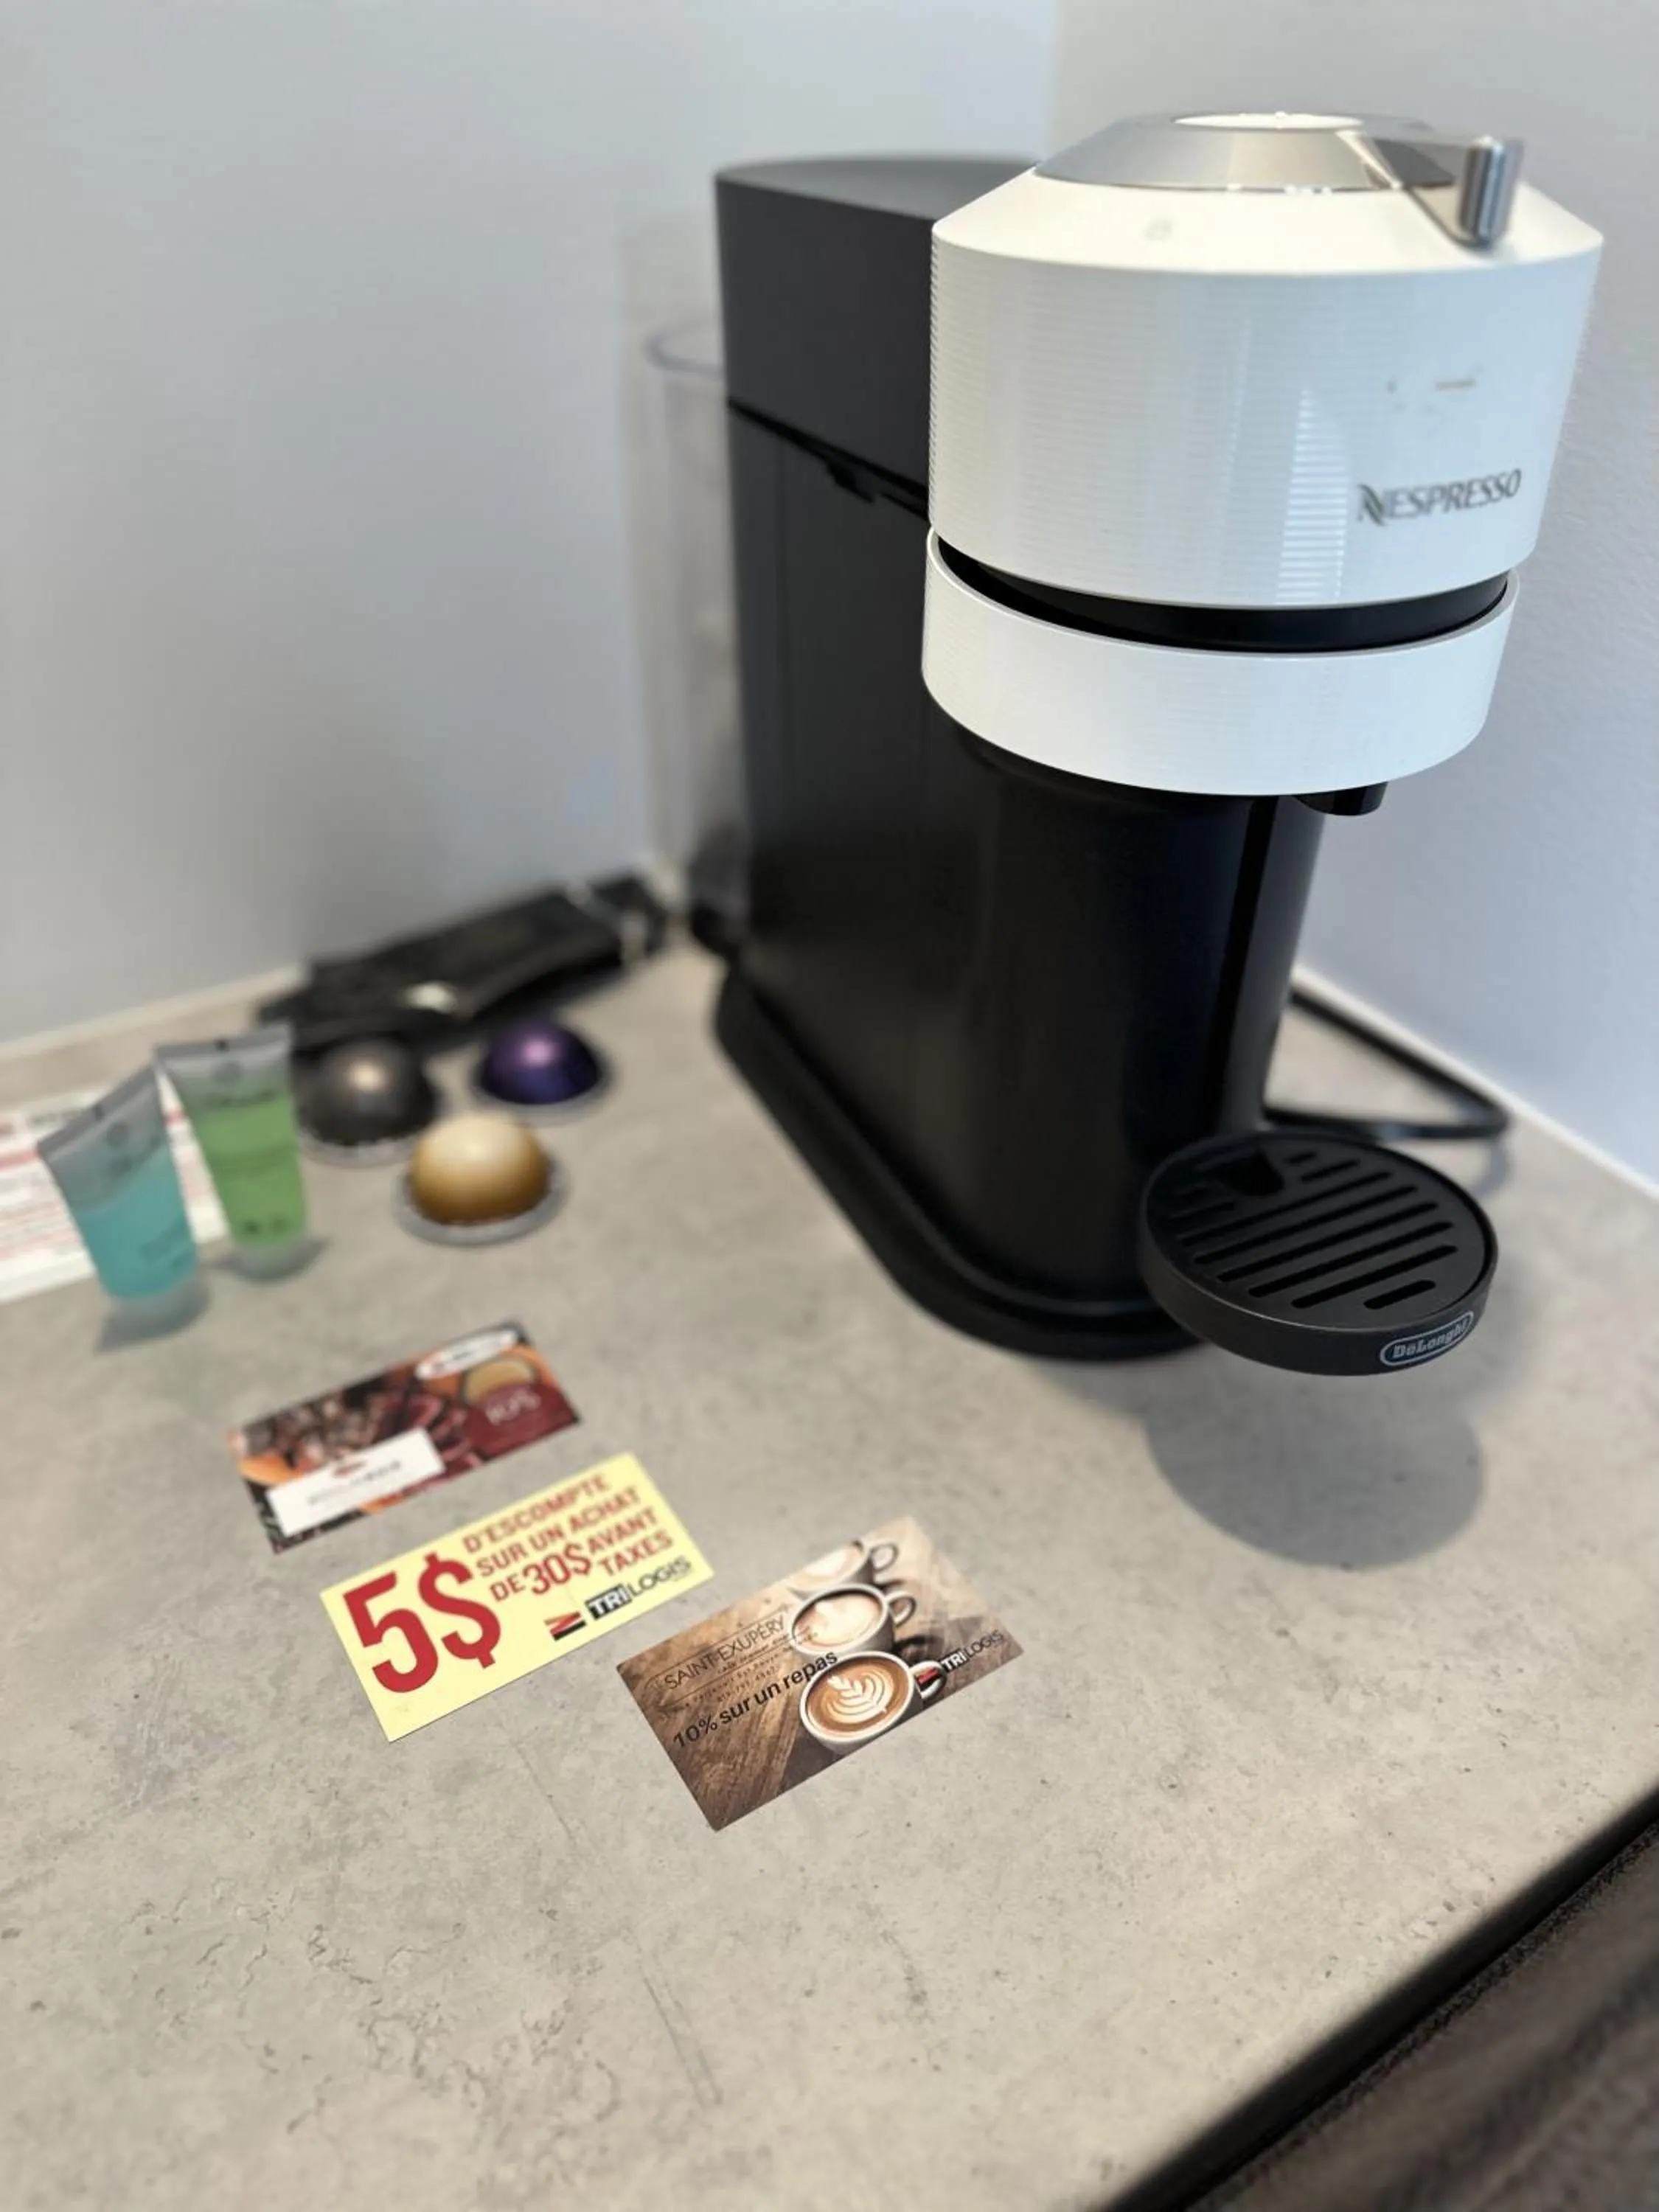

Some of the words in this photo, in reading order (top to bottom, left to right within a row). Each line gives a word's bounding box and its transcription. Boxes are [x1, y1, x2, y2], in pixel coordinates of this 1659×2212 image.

[1356, 468, 1522, 526] NESPRESSO
[463, 1474, 608, 1553] D'ESCOMPTE
[476, 1542, 528, 1576] SUR
[528, 1524, 565, 1551] UN
[568, 1485, 639, 1531] ACHAT
[490, 1573, 526, 1601] DE
[522, 1541, 592, 1595] 30$
[587, 1506, 657, 1552] AVANT
[599, 1529, 672, 1576] TAXES
[343, 1551, 501, 1693] 5$
[673, 1714, 717, 1747] 10%
[720, 1697, 752, 1725] sur
[754, 1683, 782, 1705] un
[782, 1651, 838, 1690] repas
